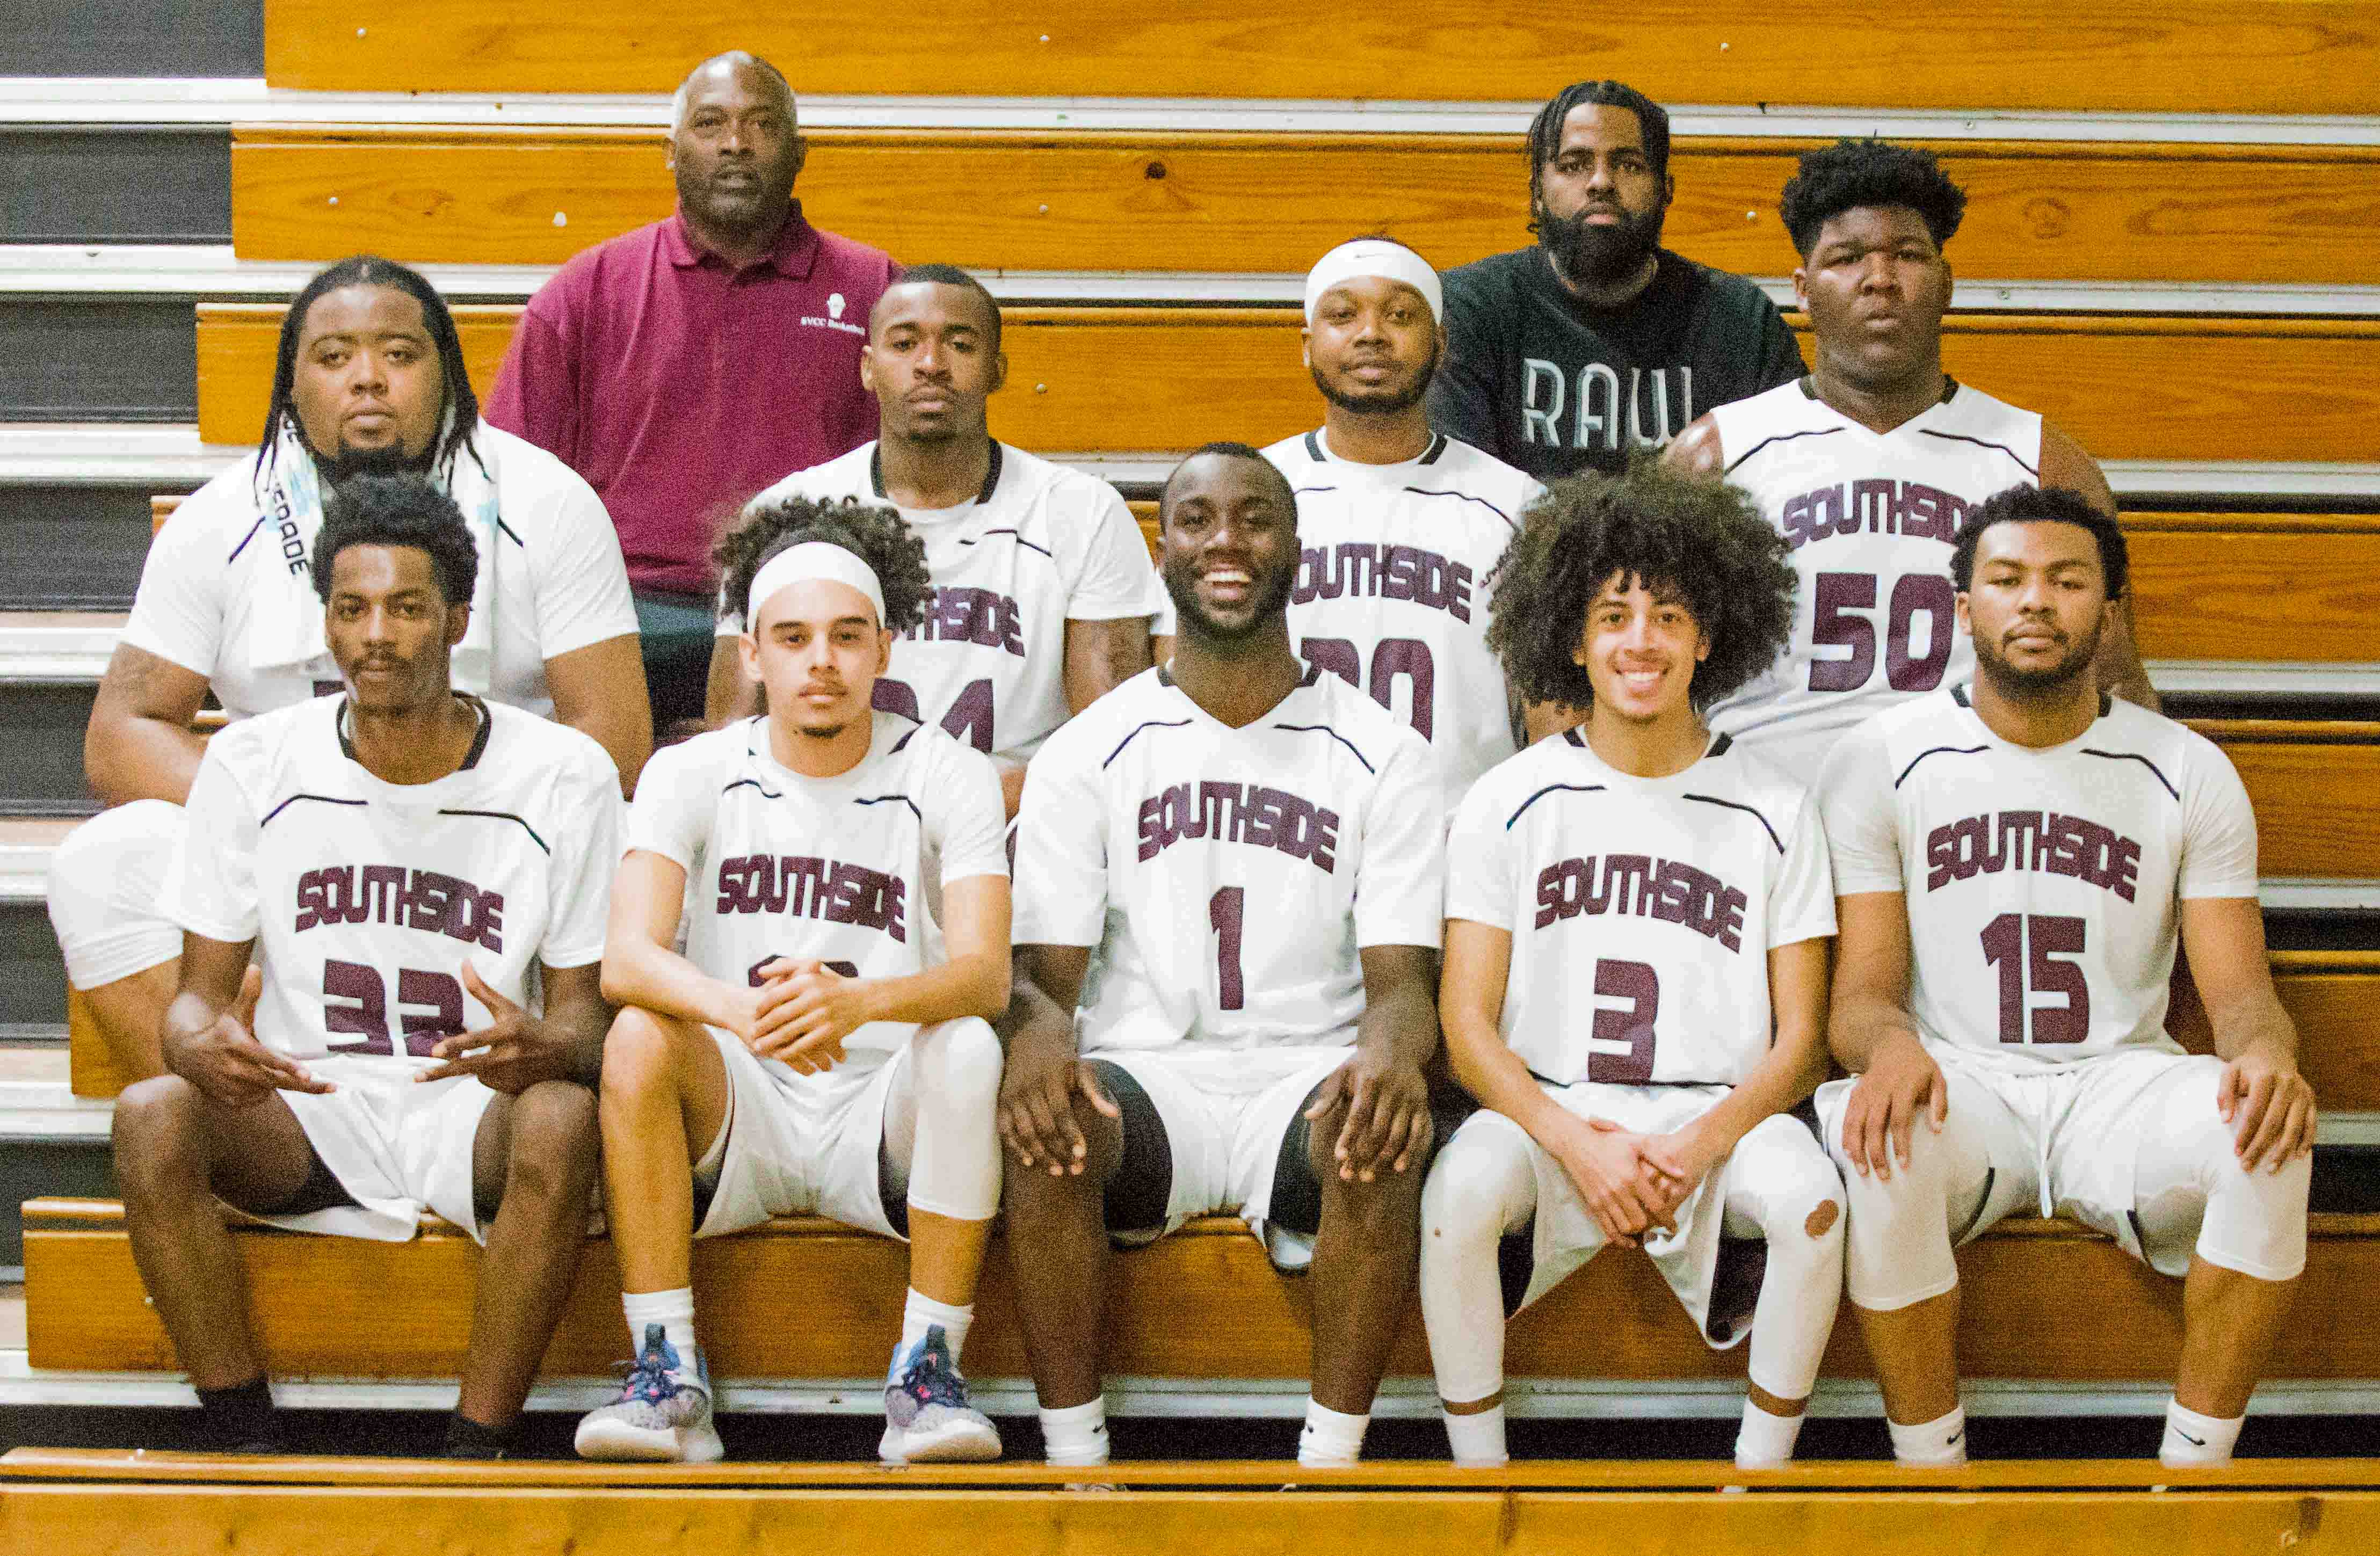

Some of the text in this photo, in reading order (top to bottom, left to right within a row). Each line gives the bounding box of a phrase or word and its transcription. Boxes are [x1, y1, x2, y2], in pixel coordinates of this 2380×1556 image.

[1521, 358, 1692, 449] RAW
[273, 485, 312, 576] ERADE
[1781, 478, 1983, 549] SOUTHSID
[1291, 542, 1473, 624] OUTHSIDE
[1808, 572, 1956, 692] 50
[1138, 780, 1339, 875] SOUTHSIDE
[1927, 810, 2142, 904] SOUTHSIDE
[295, 865, 505, 955] SOUTHSIDE
[716, 854, 906, 944] SOUTHSIDE
[1535, 854, 1747, 955] SOUTHSIDE
[1209, 885, 1245, 1010] 1
[1980, 913, 2090, 1044] 15
[1587, 958, 1660, 1085] 3
